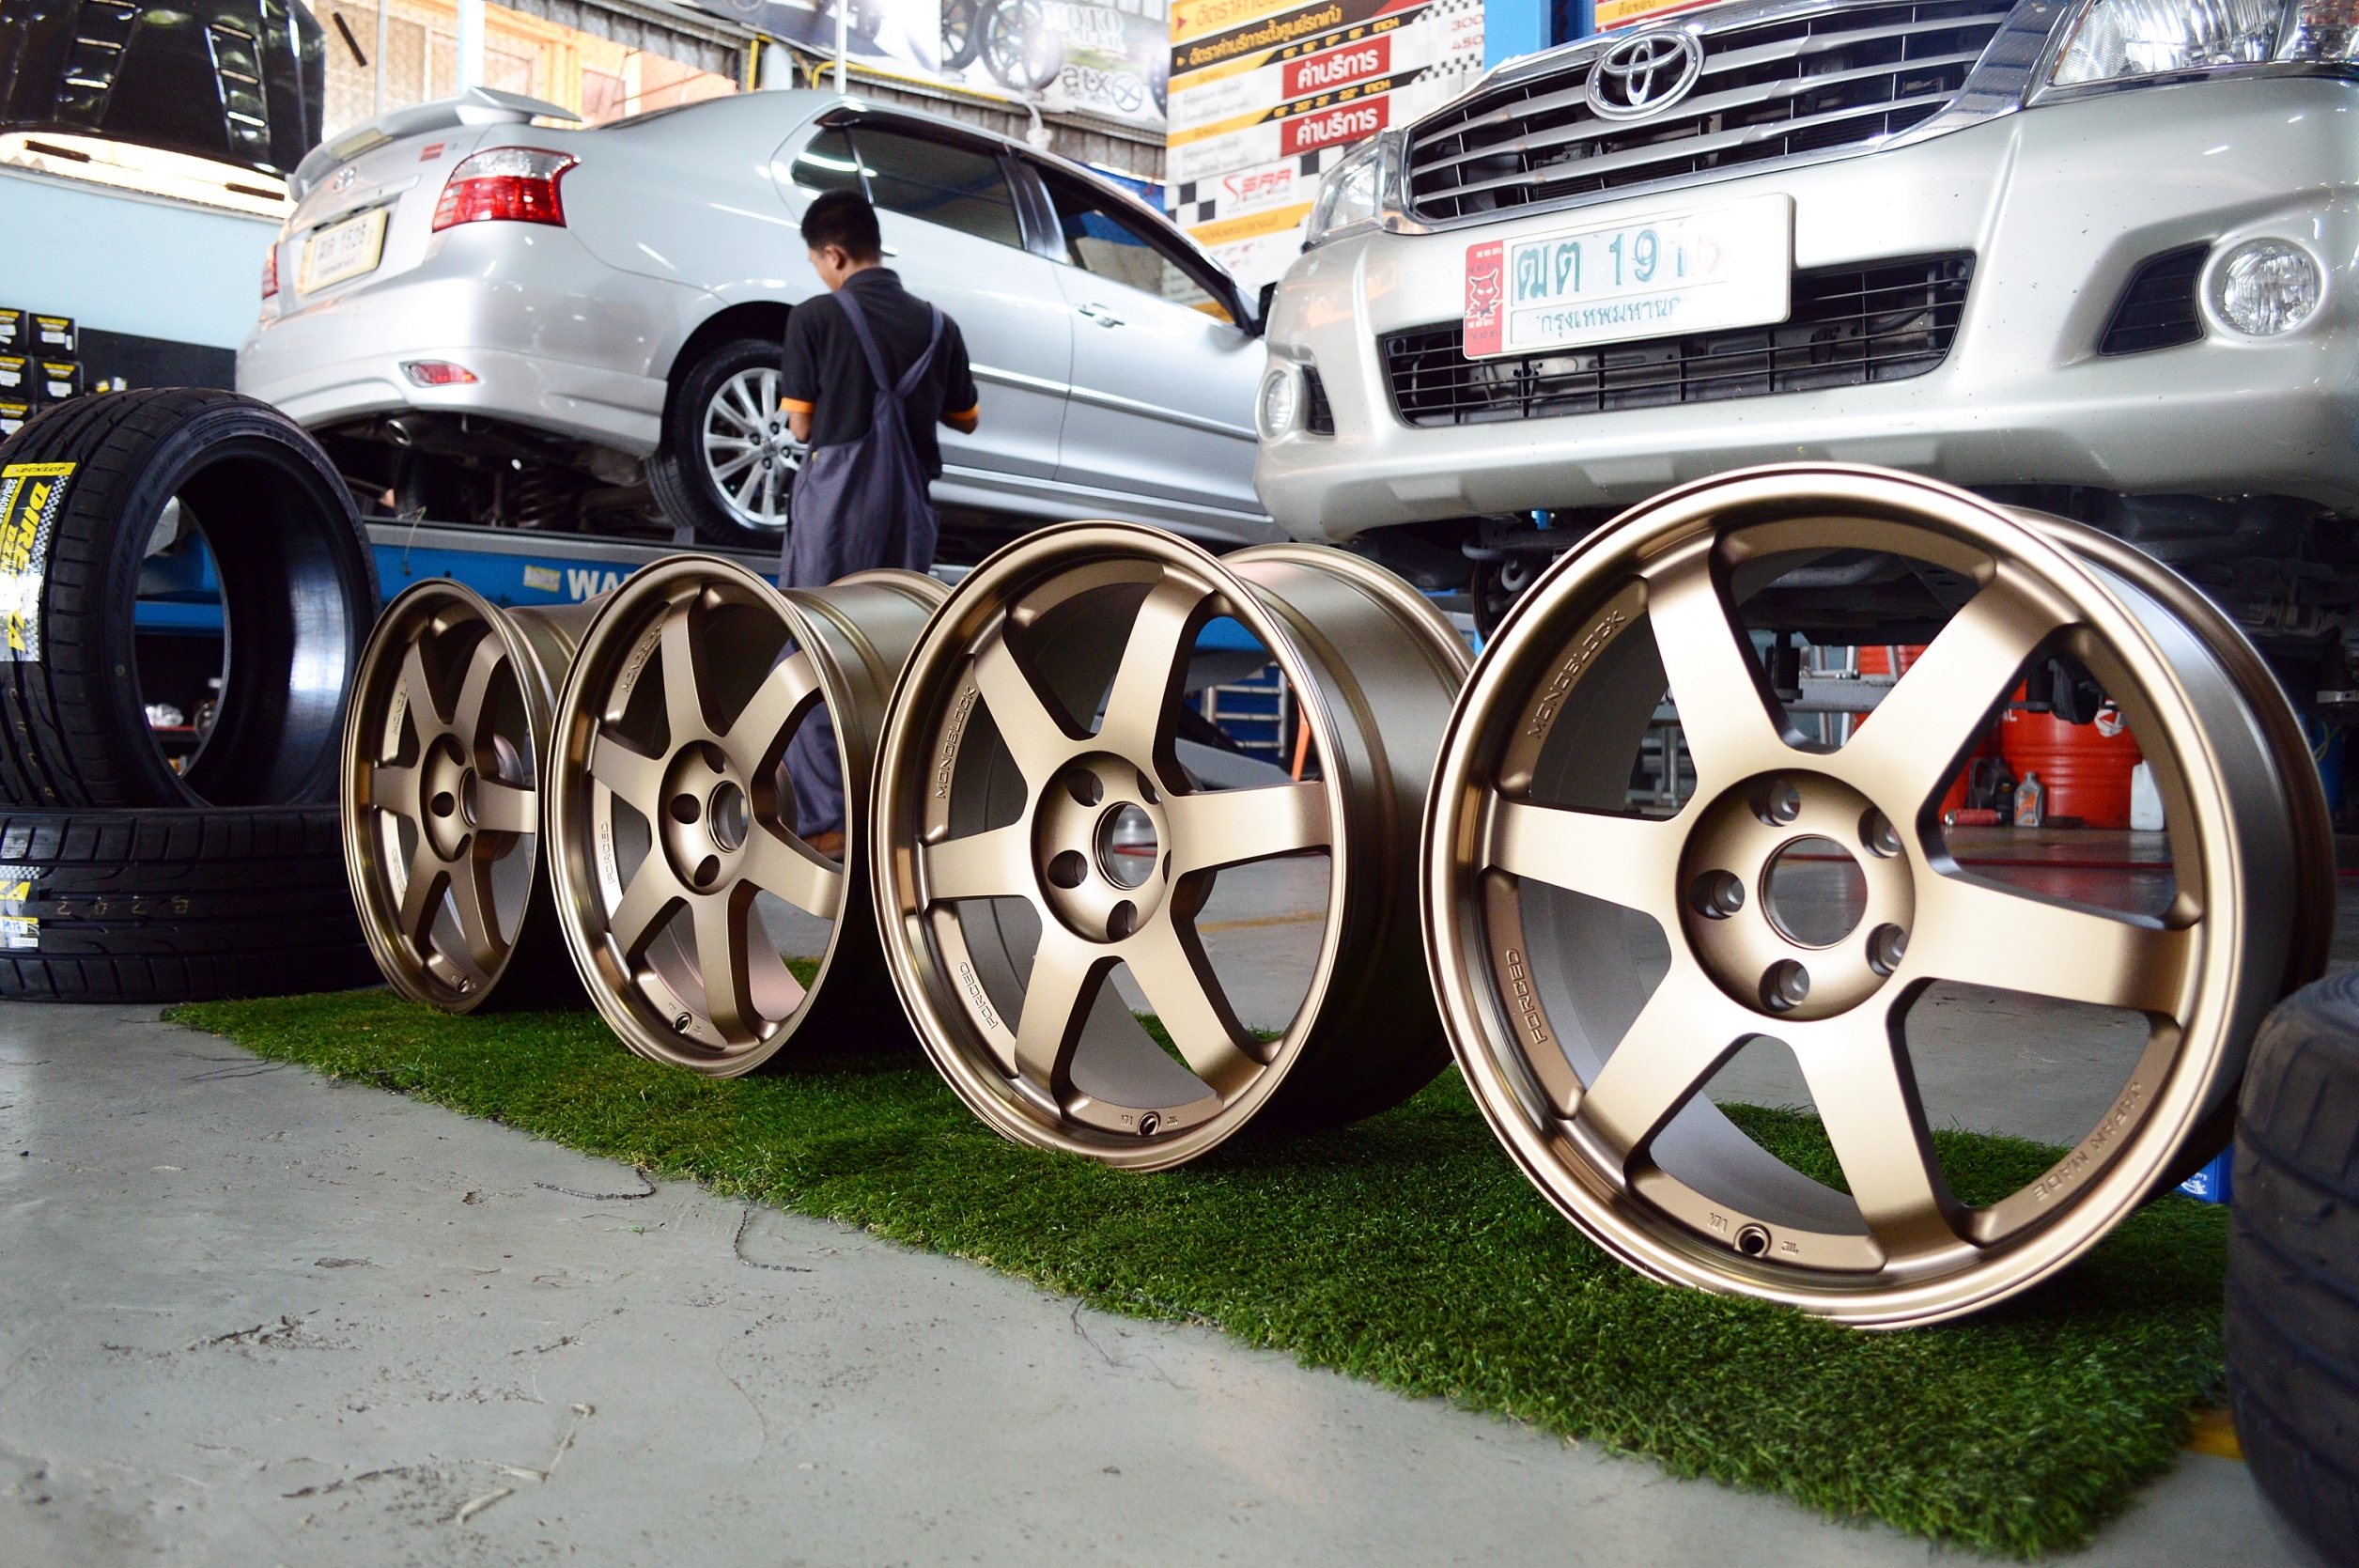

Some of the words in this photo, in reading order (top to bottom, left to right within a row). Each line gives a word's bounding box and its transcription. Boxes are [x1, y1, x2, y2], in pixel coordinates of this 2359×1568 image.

[1297, 49, 1378, 89] ค่าบริการ
[1296, 108, 1378, 147] ค่าบริการ
[1541, 297, 1682, 337] กรุงเทพมหานค
[8, 481, 53, 652] DIREZA
[566, 568, 632, 600] WA
[1527, 610, 1627, 740] MONOBLOCK
[935, 685, 977, 800] MONOBLOCK
[600, 821, 616, 884] FORGED
[959, 961, 999, 1030] FORGED
[1506, 948, 1548, 1045] FORGED
[2090, 1081, 2141, 1152] JAPAN
[2032, 1150, 2089, 1202] MADE
